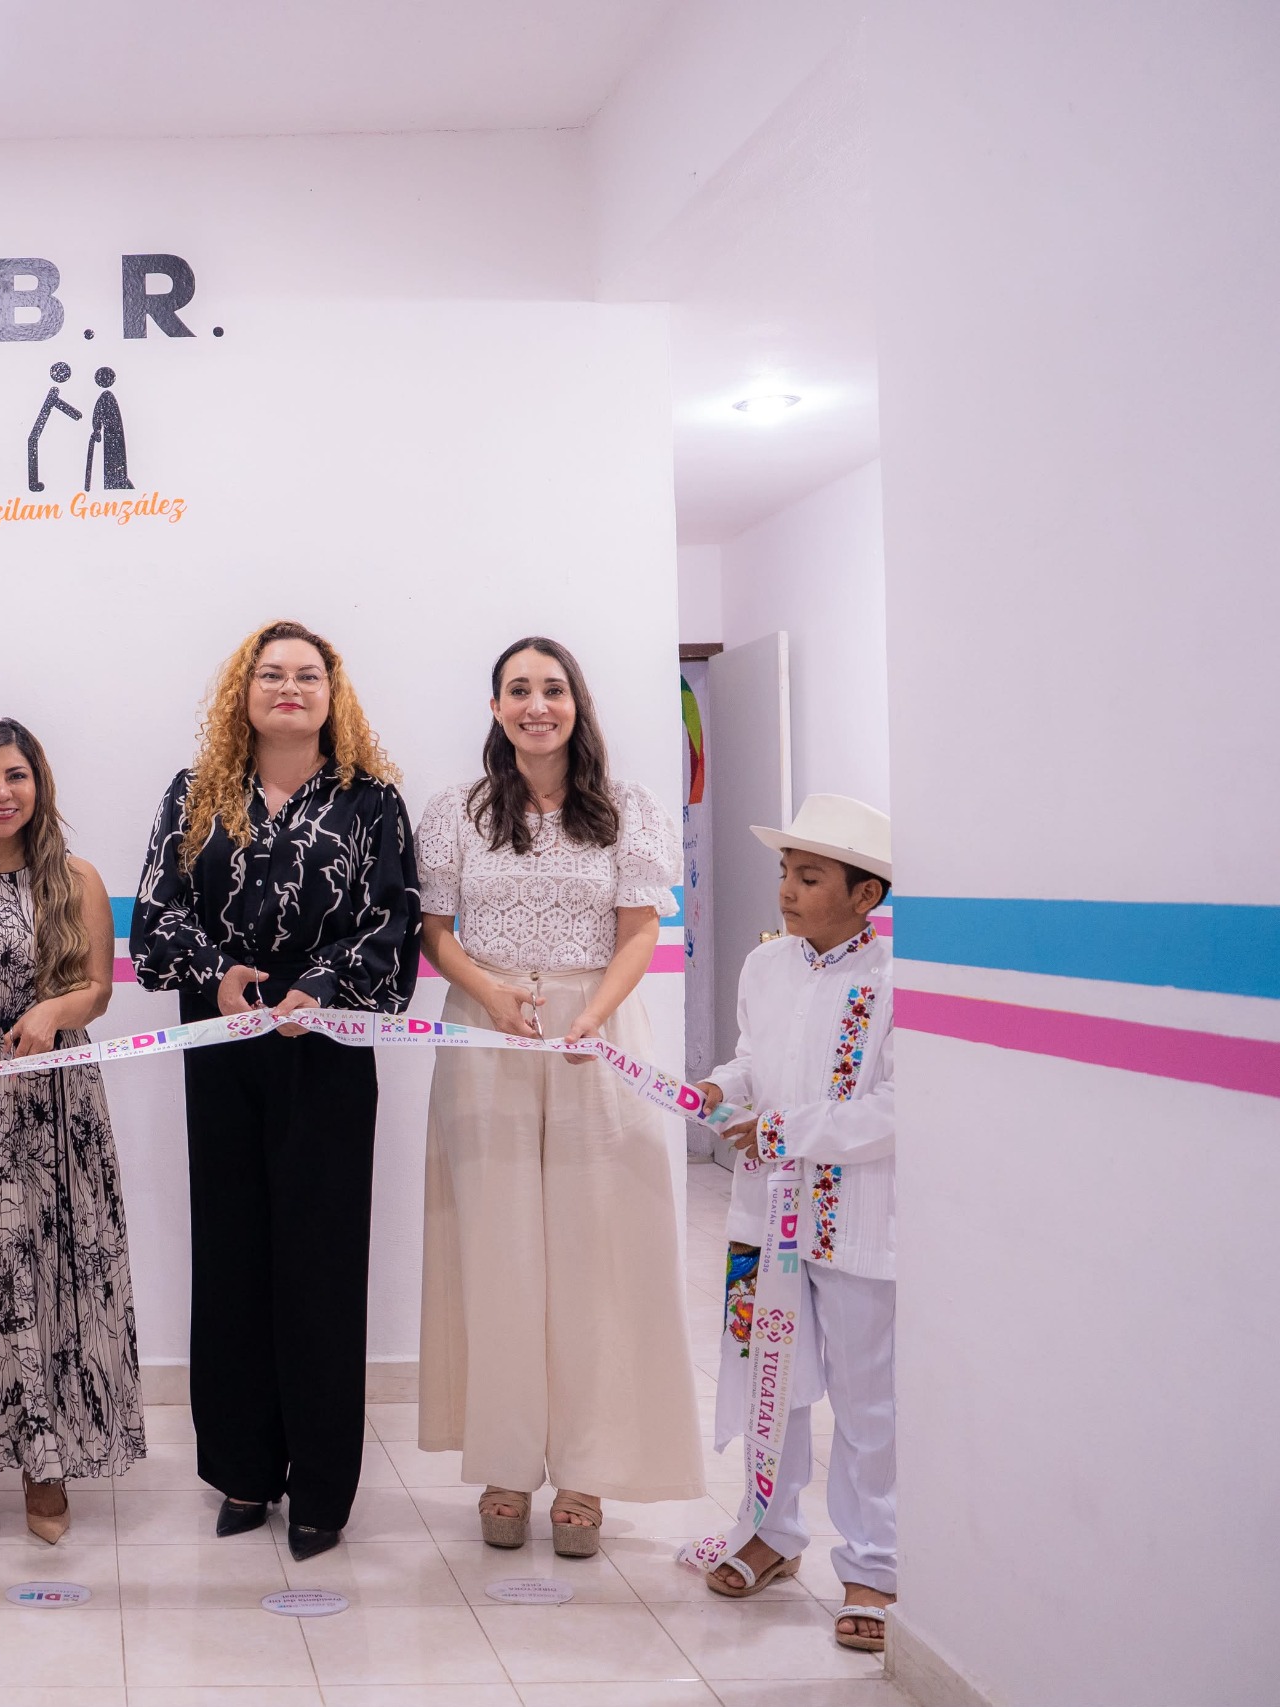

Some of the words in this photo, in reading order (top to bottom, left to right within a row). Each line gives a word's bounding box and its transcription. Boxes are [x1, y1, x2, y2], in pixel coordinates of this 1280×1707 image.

[70, 492, 187, 525] González
[131, 1026, 189, 1049] DIF
[271, 1014, 366, 1035] YCATÁN
[408, 1018, 468, 1036] DIF
[769, 1188, 778, 1225] YUCATÁN
[762, 1233, 774, 1273] 2024-2030
[777, 1214, 799, 1274] DIF
[756, 1351, 780, 1440] YUCATÁN
[778, 1353, 791, 1418] RENACIMIENTO
[753, 1470, 774, 1529] DIF
[19, 1592, 62, 1601] DIF
